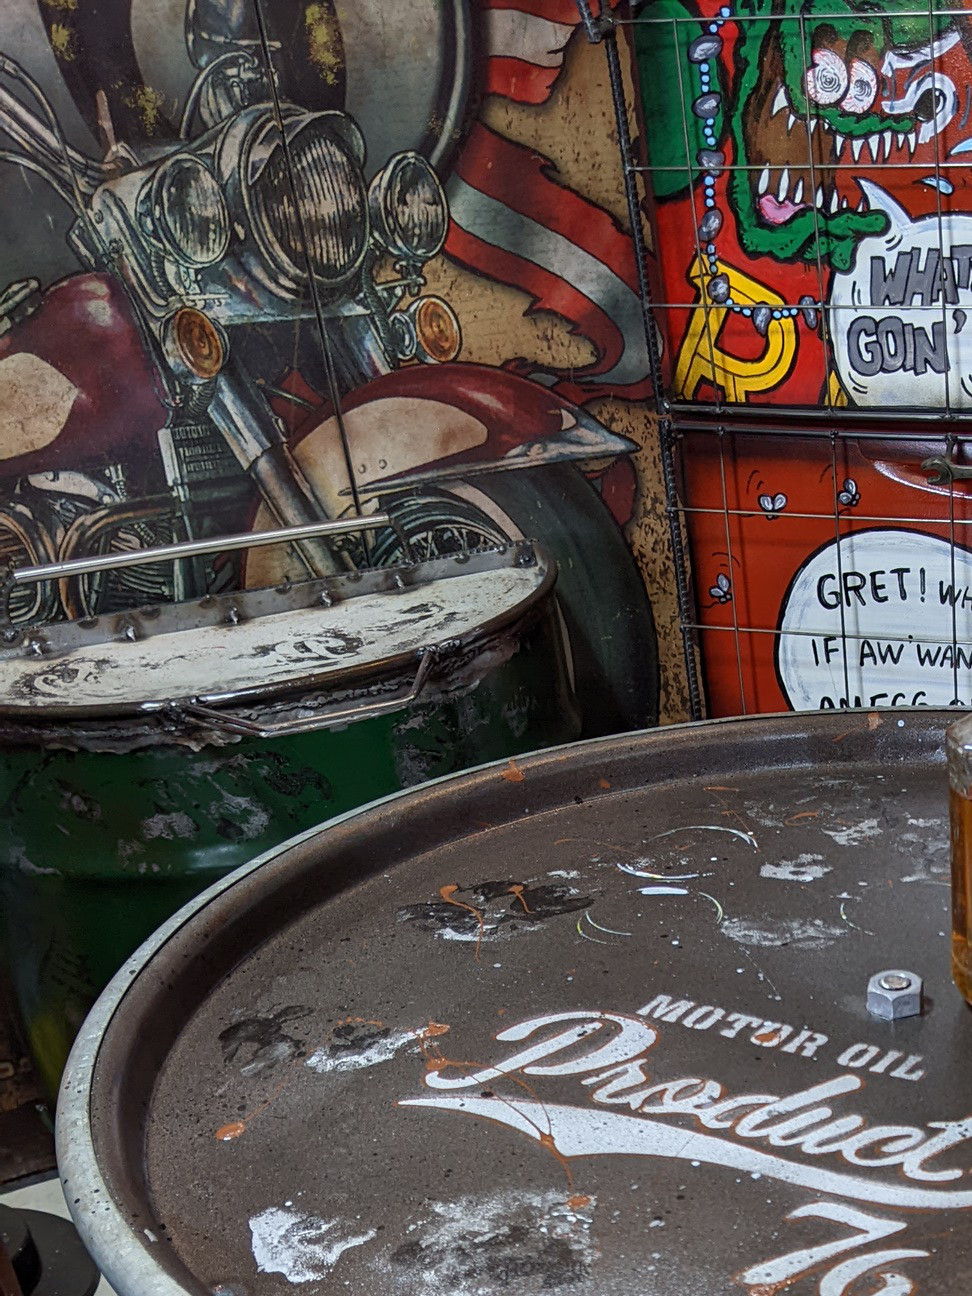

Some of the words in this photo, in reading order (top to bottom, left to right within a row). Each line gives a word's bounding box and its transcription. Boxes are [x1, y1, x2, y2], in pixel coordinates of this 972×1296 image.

[847, 309, 967, 377] GOIN'
[816, 567, 926, 610] GRET!
[811, 636, 840, 666] IF
[636, 994, 829, 1057] MOTOR
[836, 1042, 926, 1082] OIL
